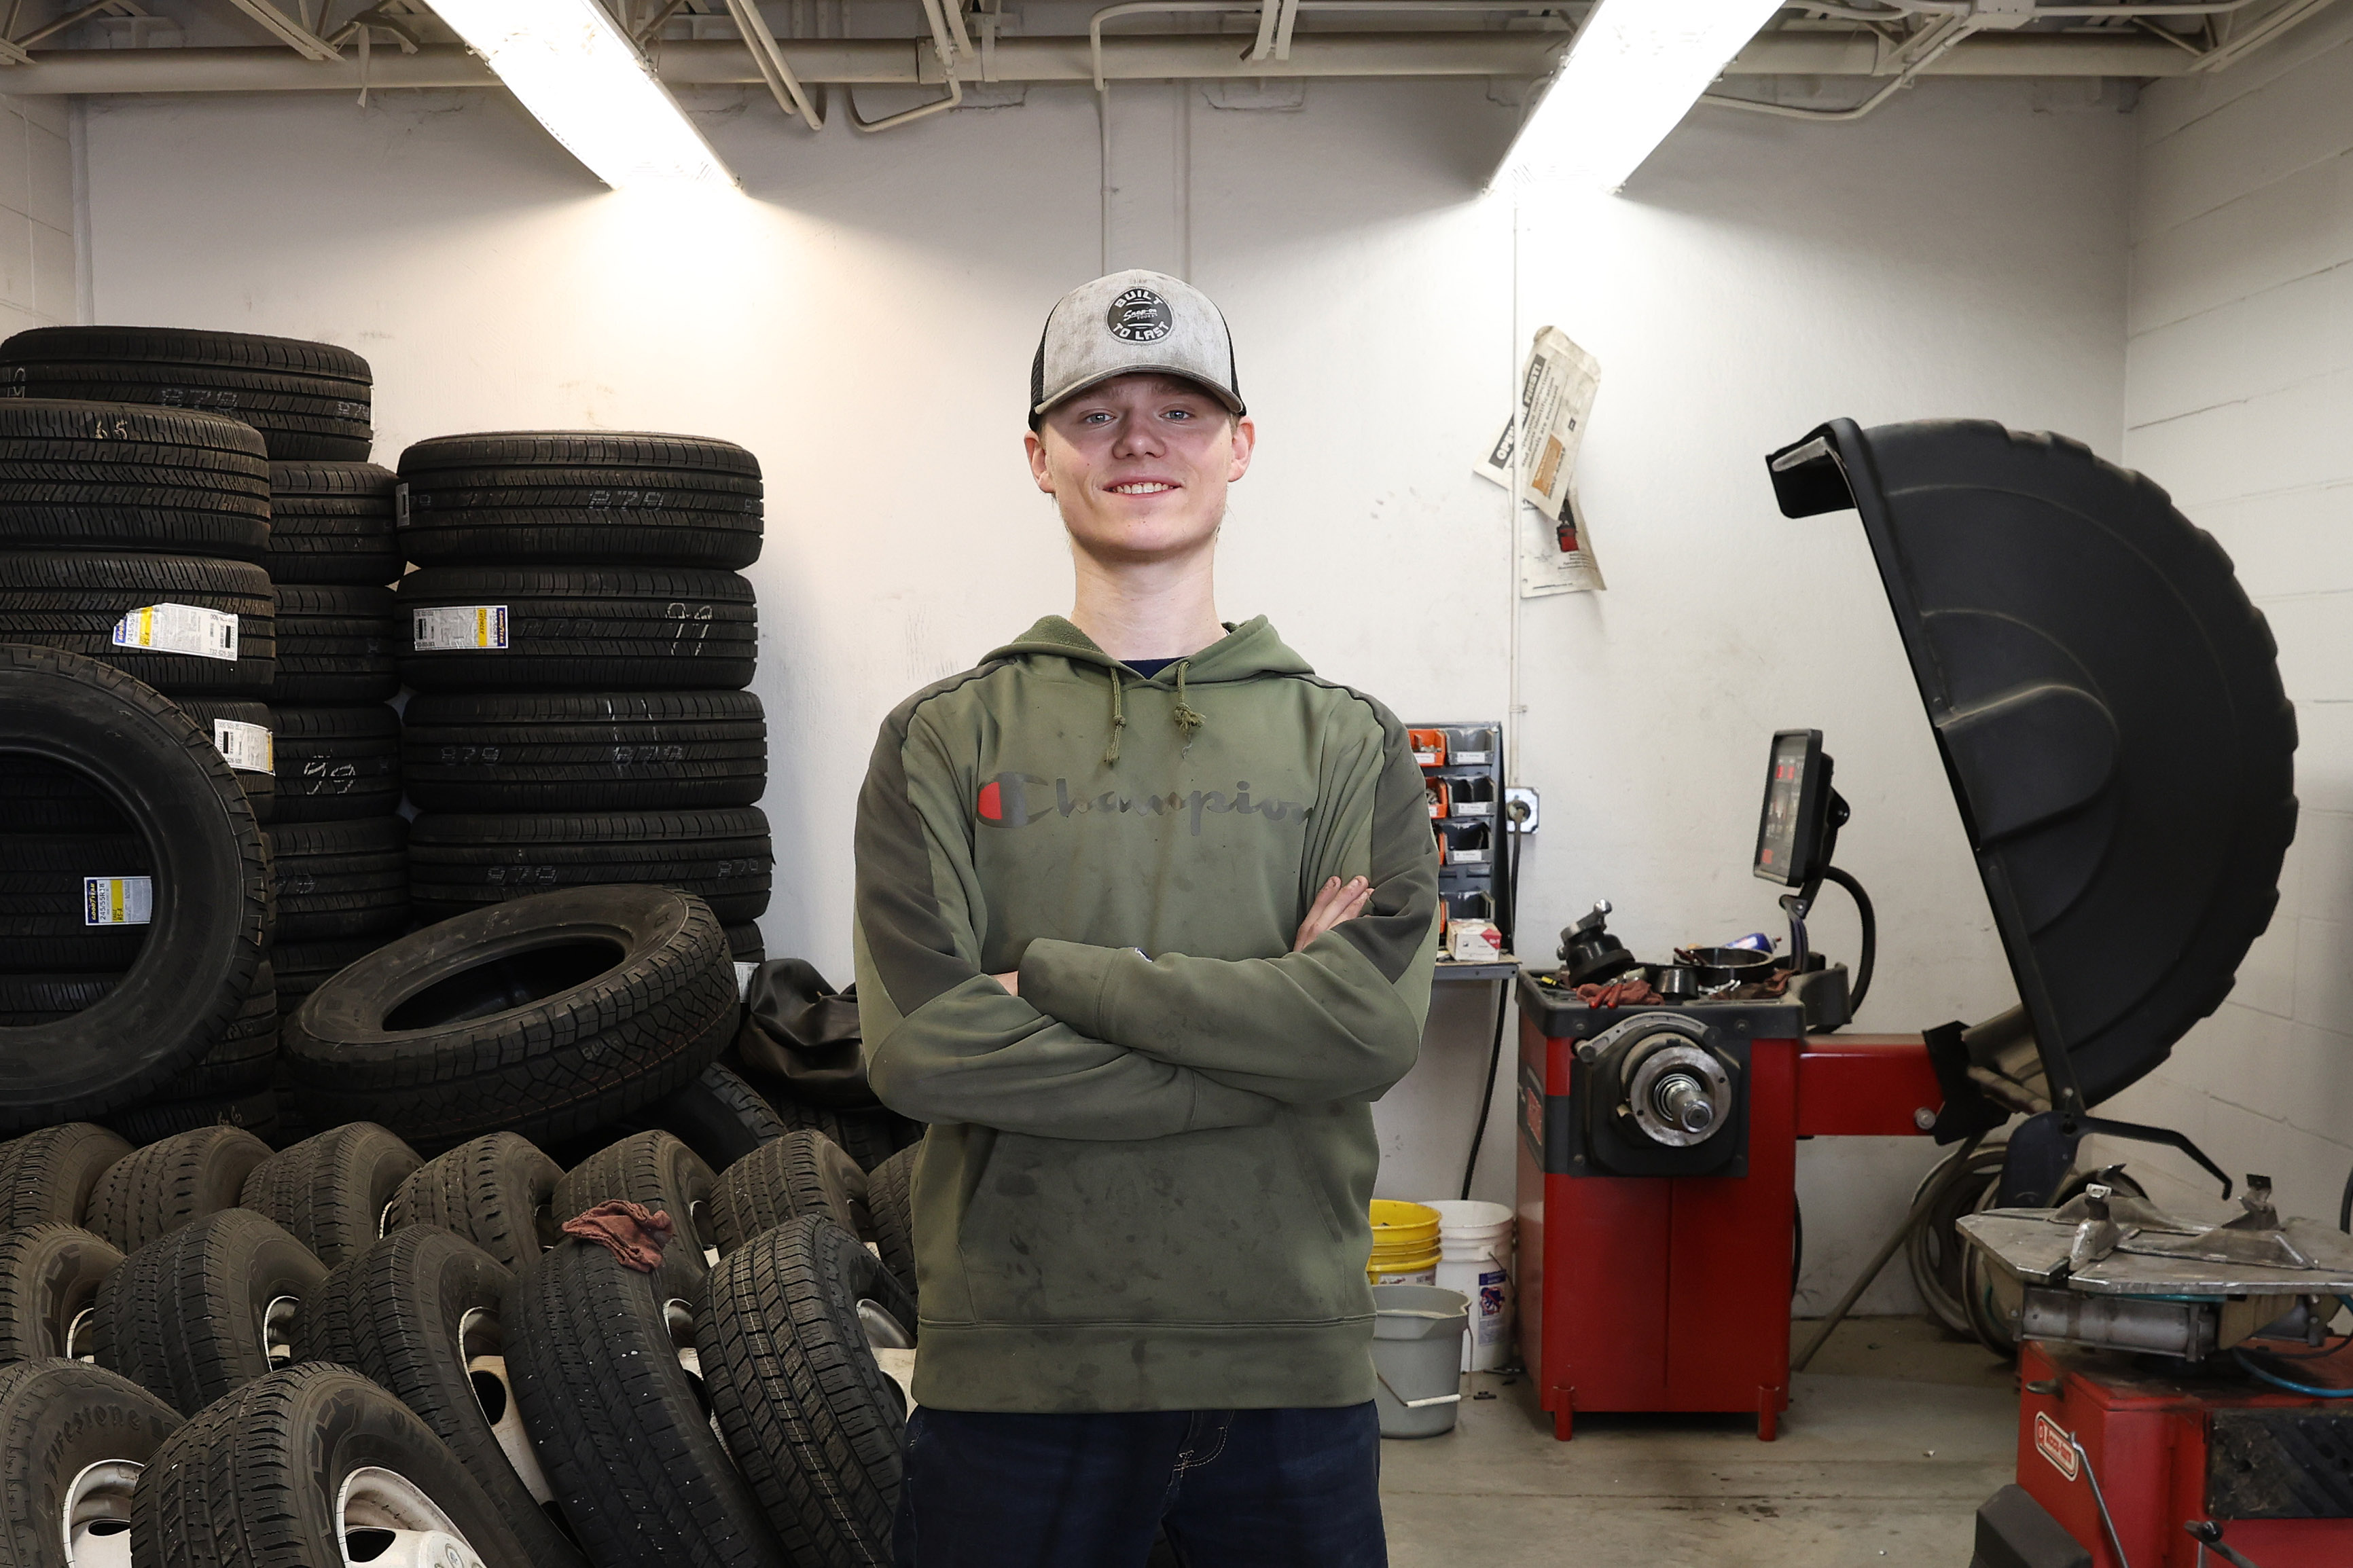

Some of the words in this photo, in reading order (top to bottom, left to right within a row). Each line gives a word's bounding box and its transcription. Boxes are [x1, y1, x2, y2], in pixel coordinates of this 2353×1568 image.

[1115, 290, 1163, 308] BUILT
[1123, 308, 1157, 321] Snap-on
[1113, 323, 1131, 338] TO
[1135, 321, 1169, 340] LAST
[1524, 363, 1543, 405] FIRST!
[98, 882, 107, 921] 245/55R18
